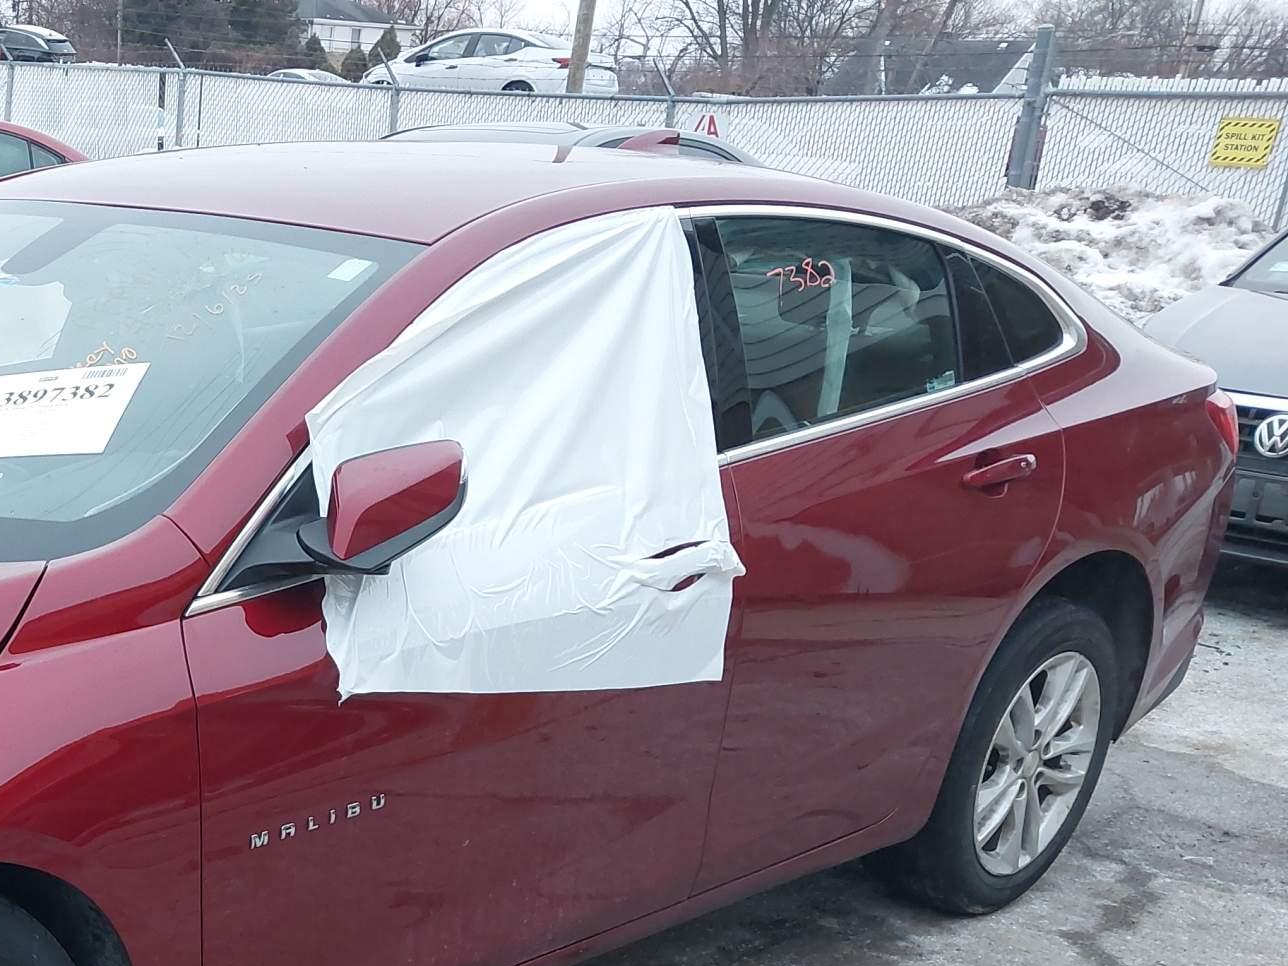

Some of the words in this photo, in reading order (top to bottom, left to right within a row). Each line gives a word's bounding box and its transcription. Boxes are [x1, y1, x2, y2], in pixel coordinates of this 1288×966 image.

[1223, 143, 1260, 152] STATION
[1224, 132, 1248, 141] SPILL
[1250, 133, 1266, 141] KIT
[766, 257, 836, 300] 7382
[249, 793, 386, 850] MALIBU
